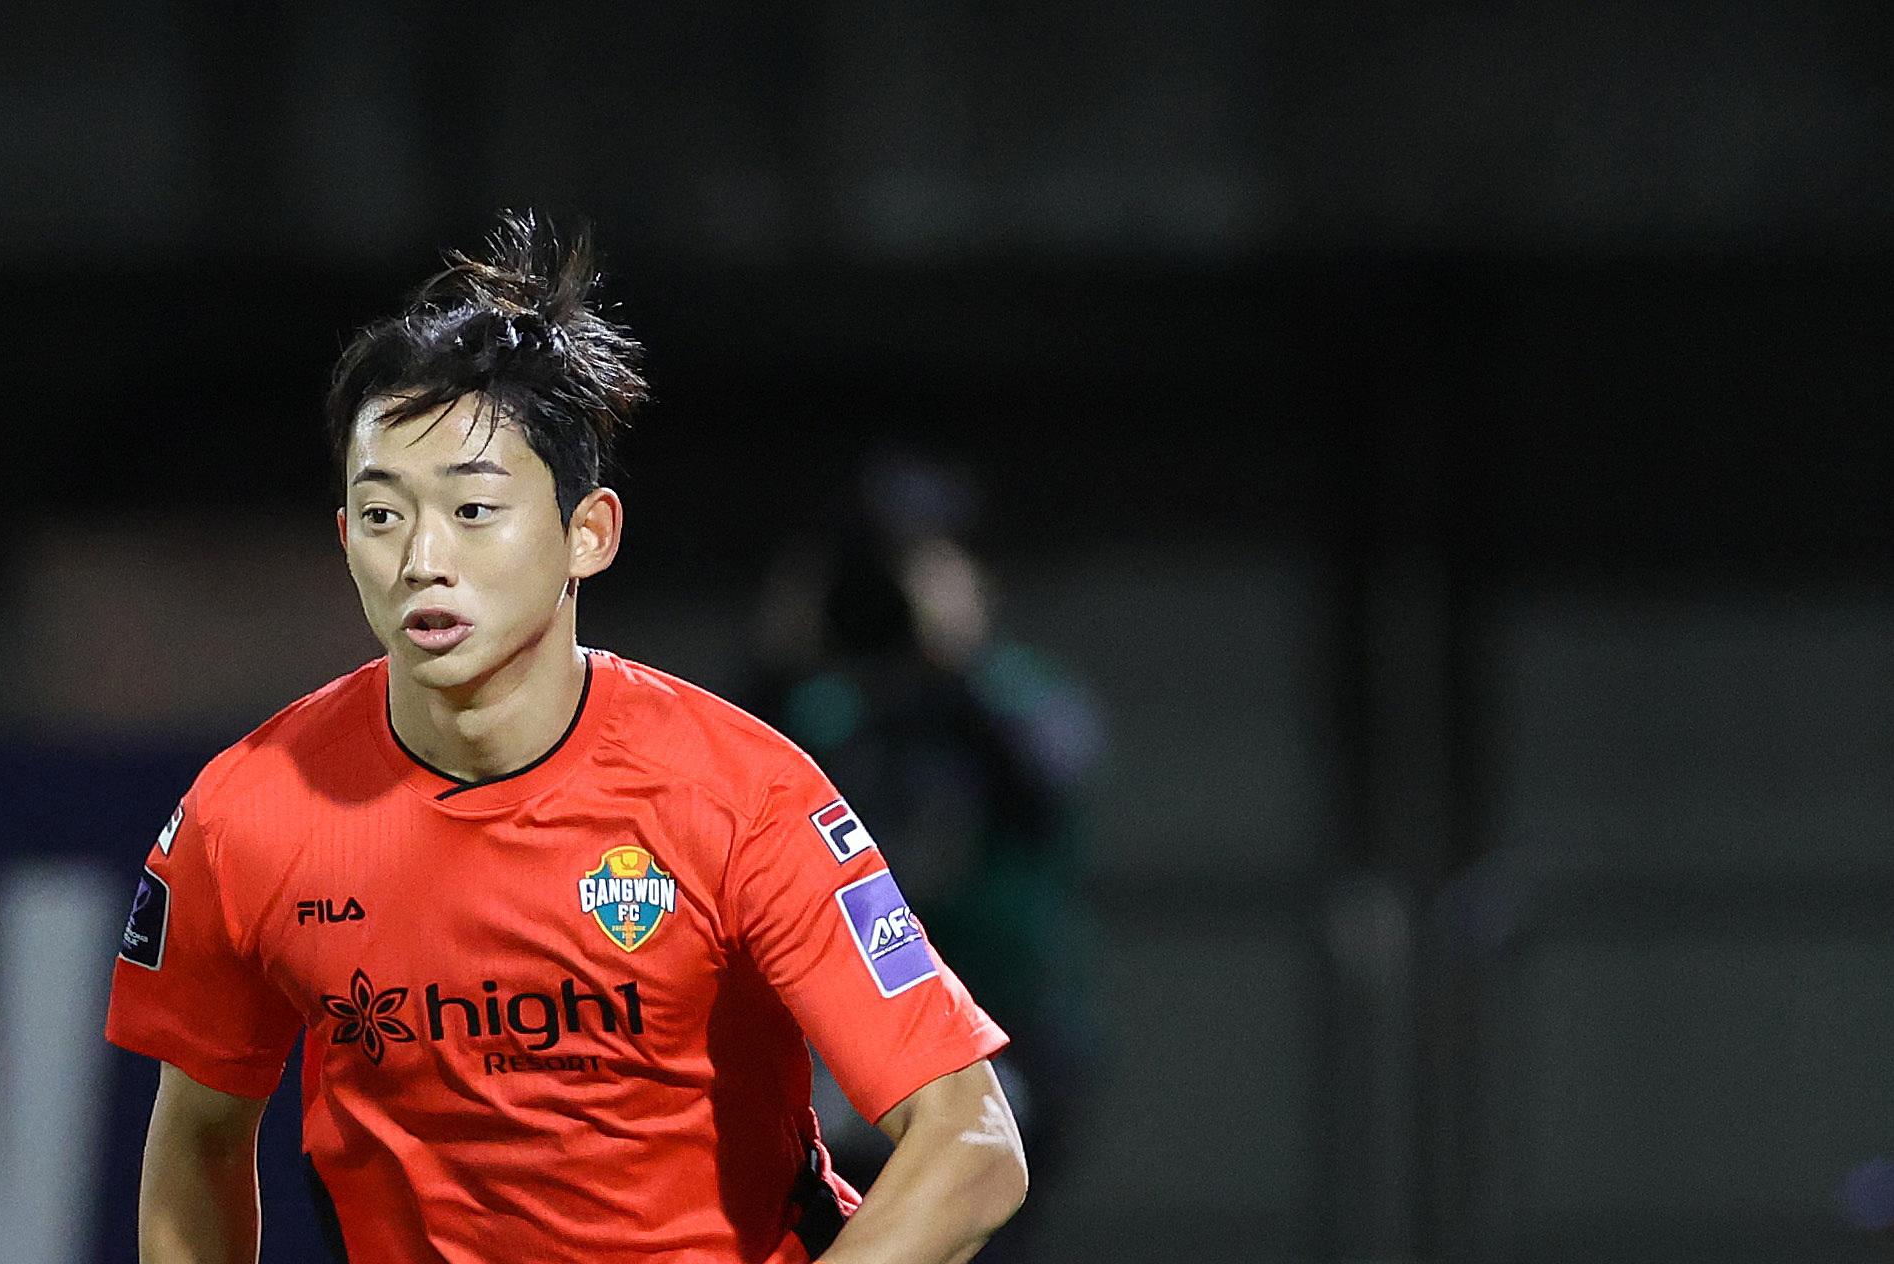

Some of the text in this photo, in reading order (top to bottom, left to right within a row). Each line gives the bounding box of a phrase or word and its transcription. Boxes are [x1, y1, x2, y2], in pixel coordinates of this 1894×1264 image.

[578, 878, 676, 914] GANGWON
[297, 897, 366, 926] FILA
[617, 904, 641, 922] FC
